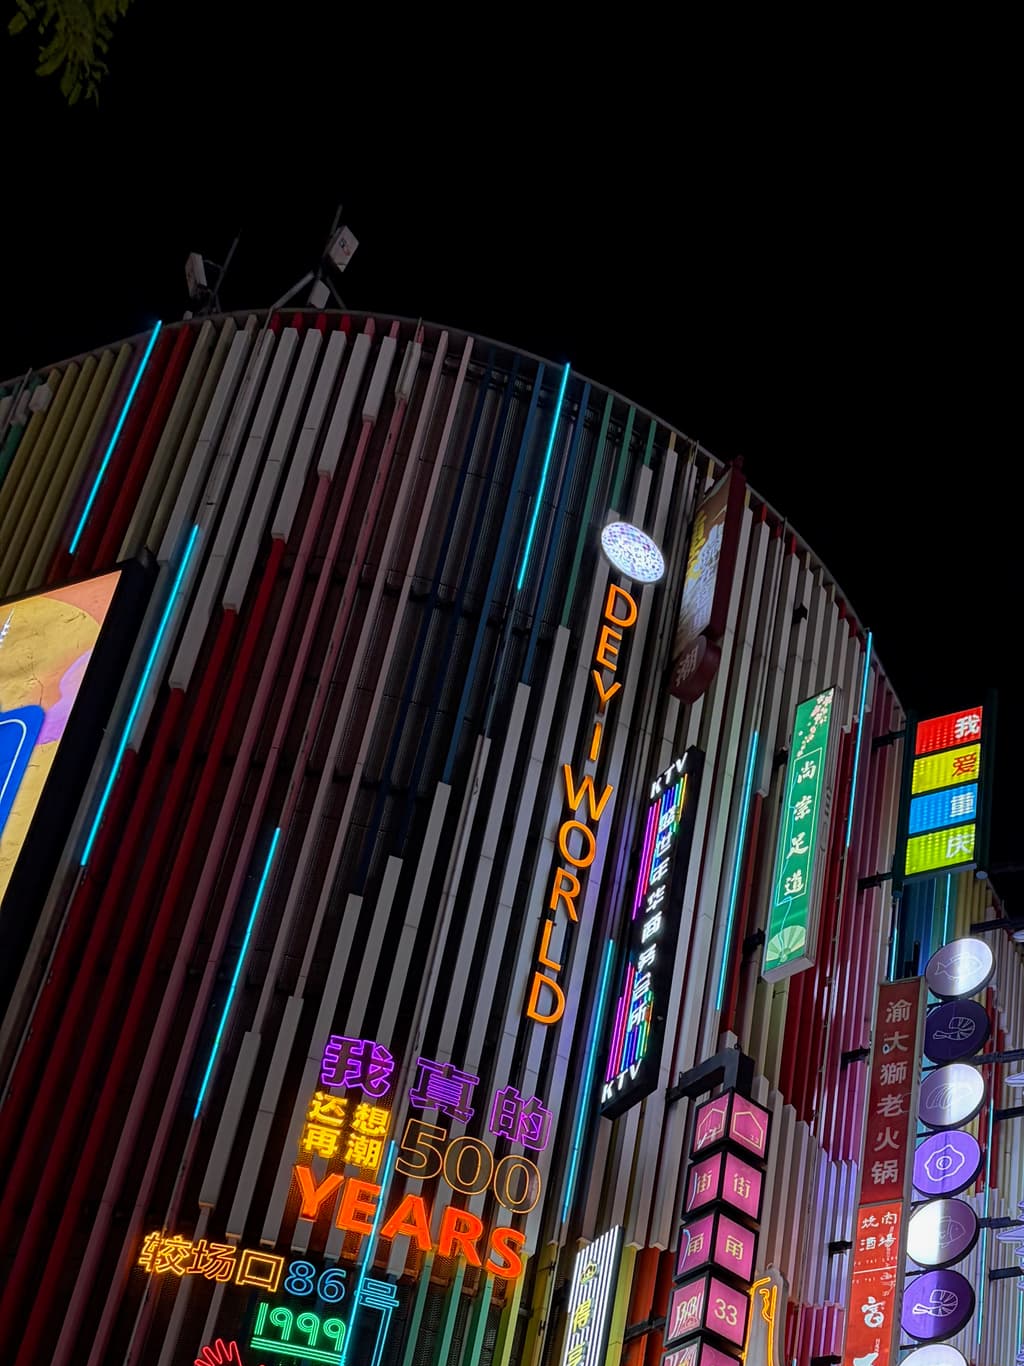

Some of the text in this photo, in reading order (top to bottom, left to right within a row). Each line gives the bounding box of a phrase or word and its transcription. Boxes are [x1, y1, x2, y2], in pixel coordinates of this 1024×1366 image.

[650, 752, 688, 799] KTV
[946, 714, 981, 859] 我爱重庆
[526, 763, 614, 1025] WORLD
[307, 1092, 391, 1136] 还想
[321, 1035, 553, 1152] 我真的
[600, 1057, 643, 1104] KTV
[301, 1123, 385, 1167] 再潮
[395, 1118, 542, 1214] 500
[293, 1164, 527, 1279] YEARS
[255, 1301, 347, 1352] 1999
